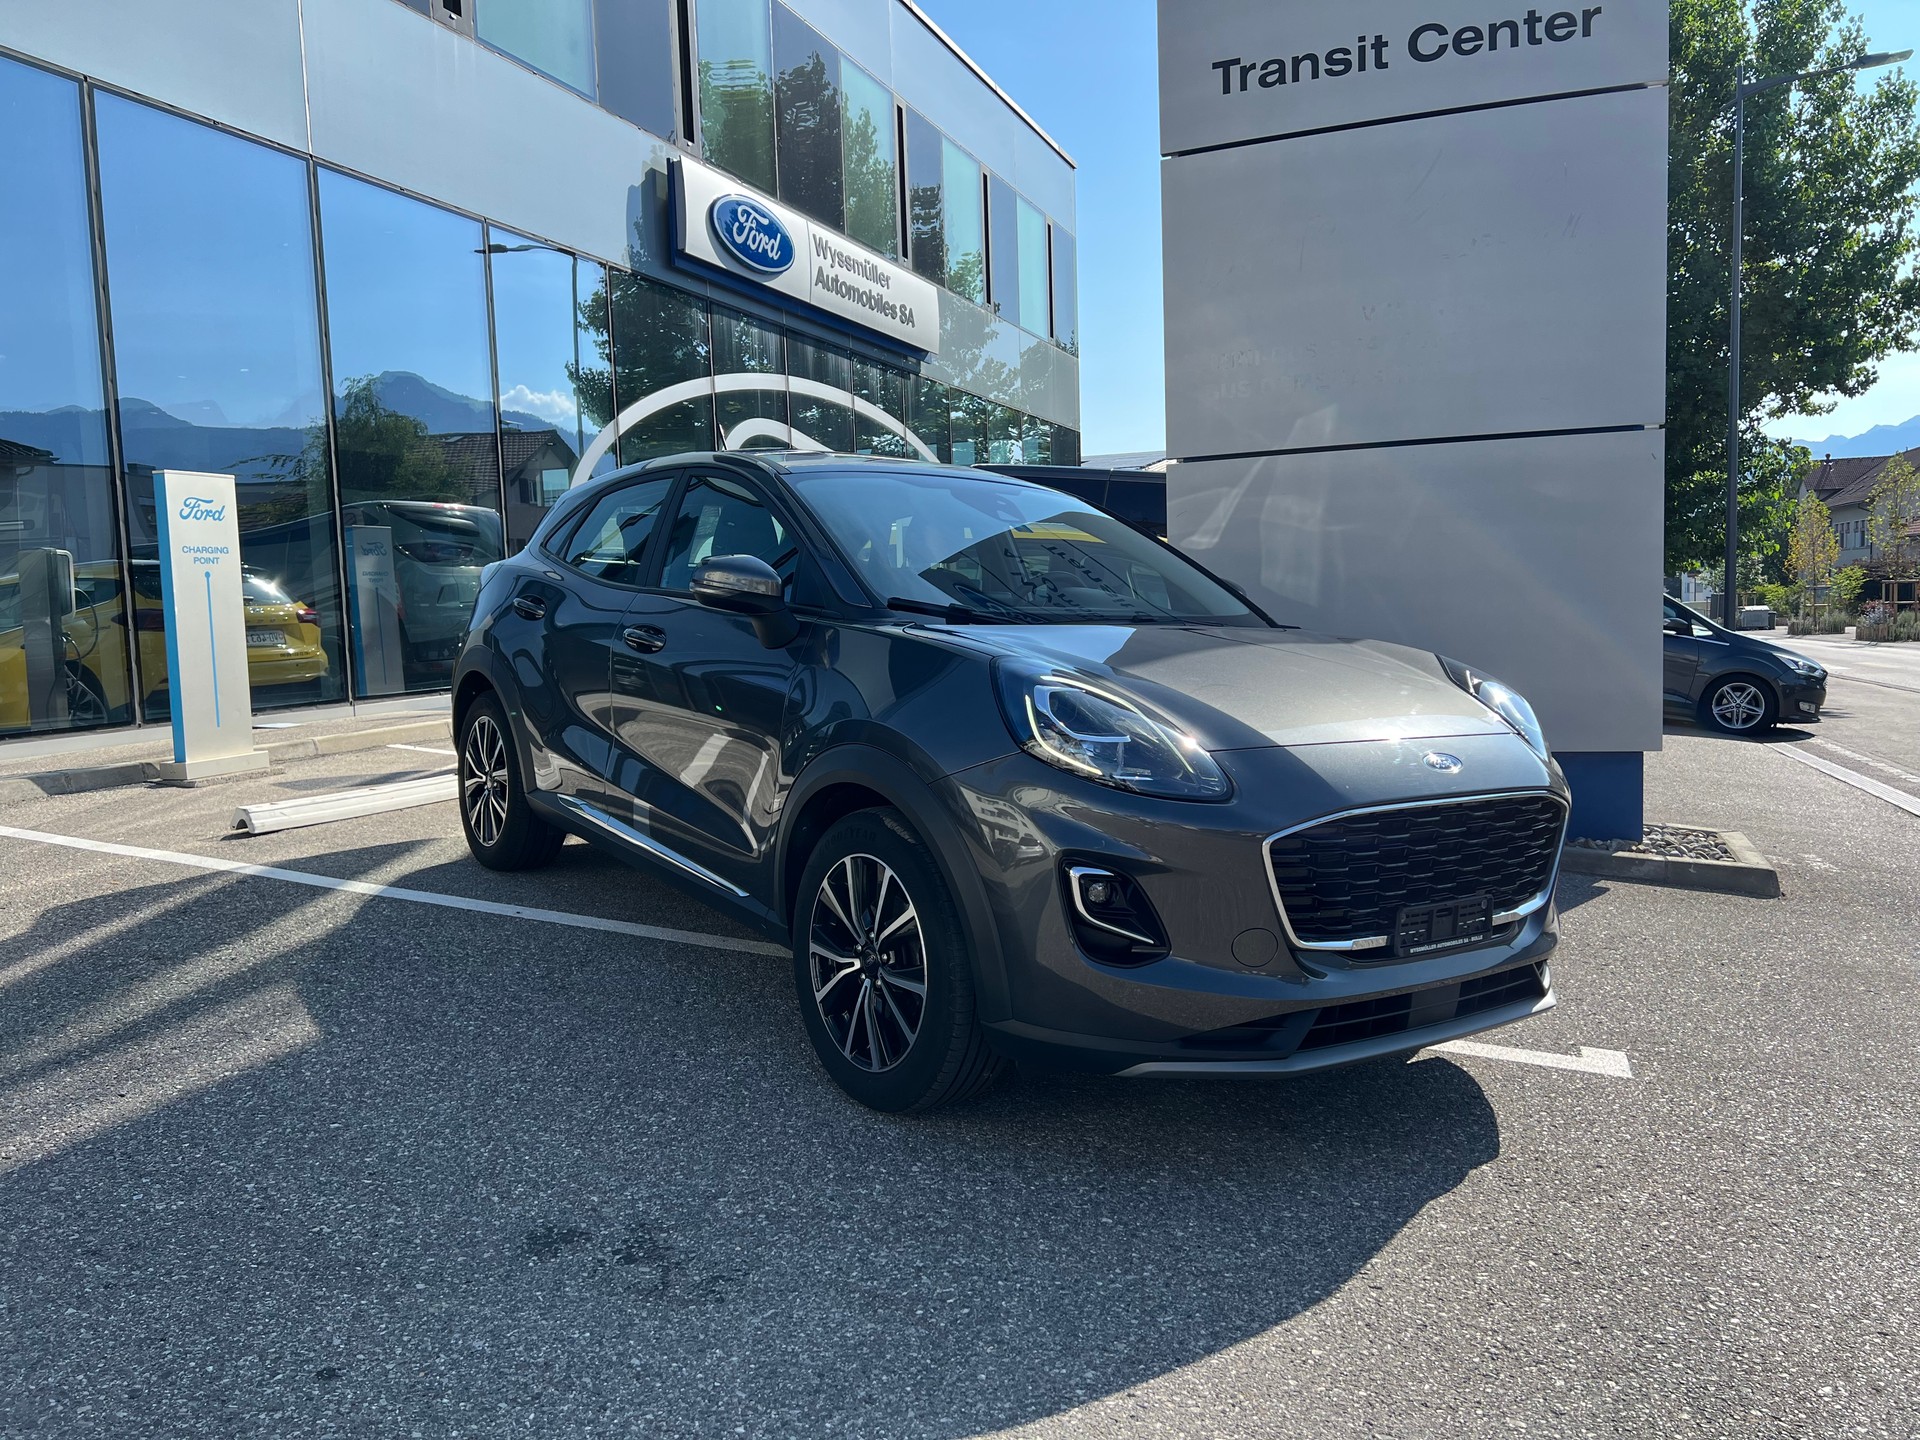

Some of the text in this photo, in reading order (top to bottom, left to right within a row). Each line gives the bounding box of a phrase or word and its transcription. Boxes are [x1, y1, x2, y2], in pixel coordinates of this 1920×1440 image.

[1212, 6, 1602, 95] Transit Center
[732, 205, 781, 260] Ford
[812, 233, 892, 290] Wyssmüller
[814, 265, 916, 328] Automobiles SA
[179, 496, 226, 522] Ford
[182, 545, 229, 555] CHARGING
[193, 556, 220, 565] POINT
